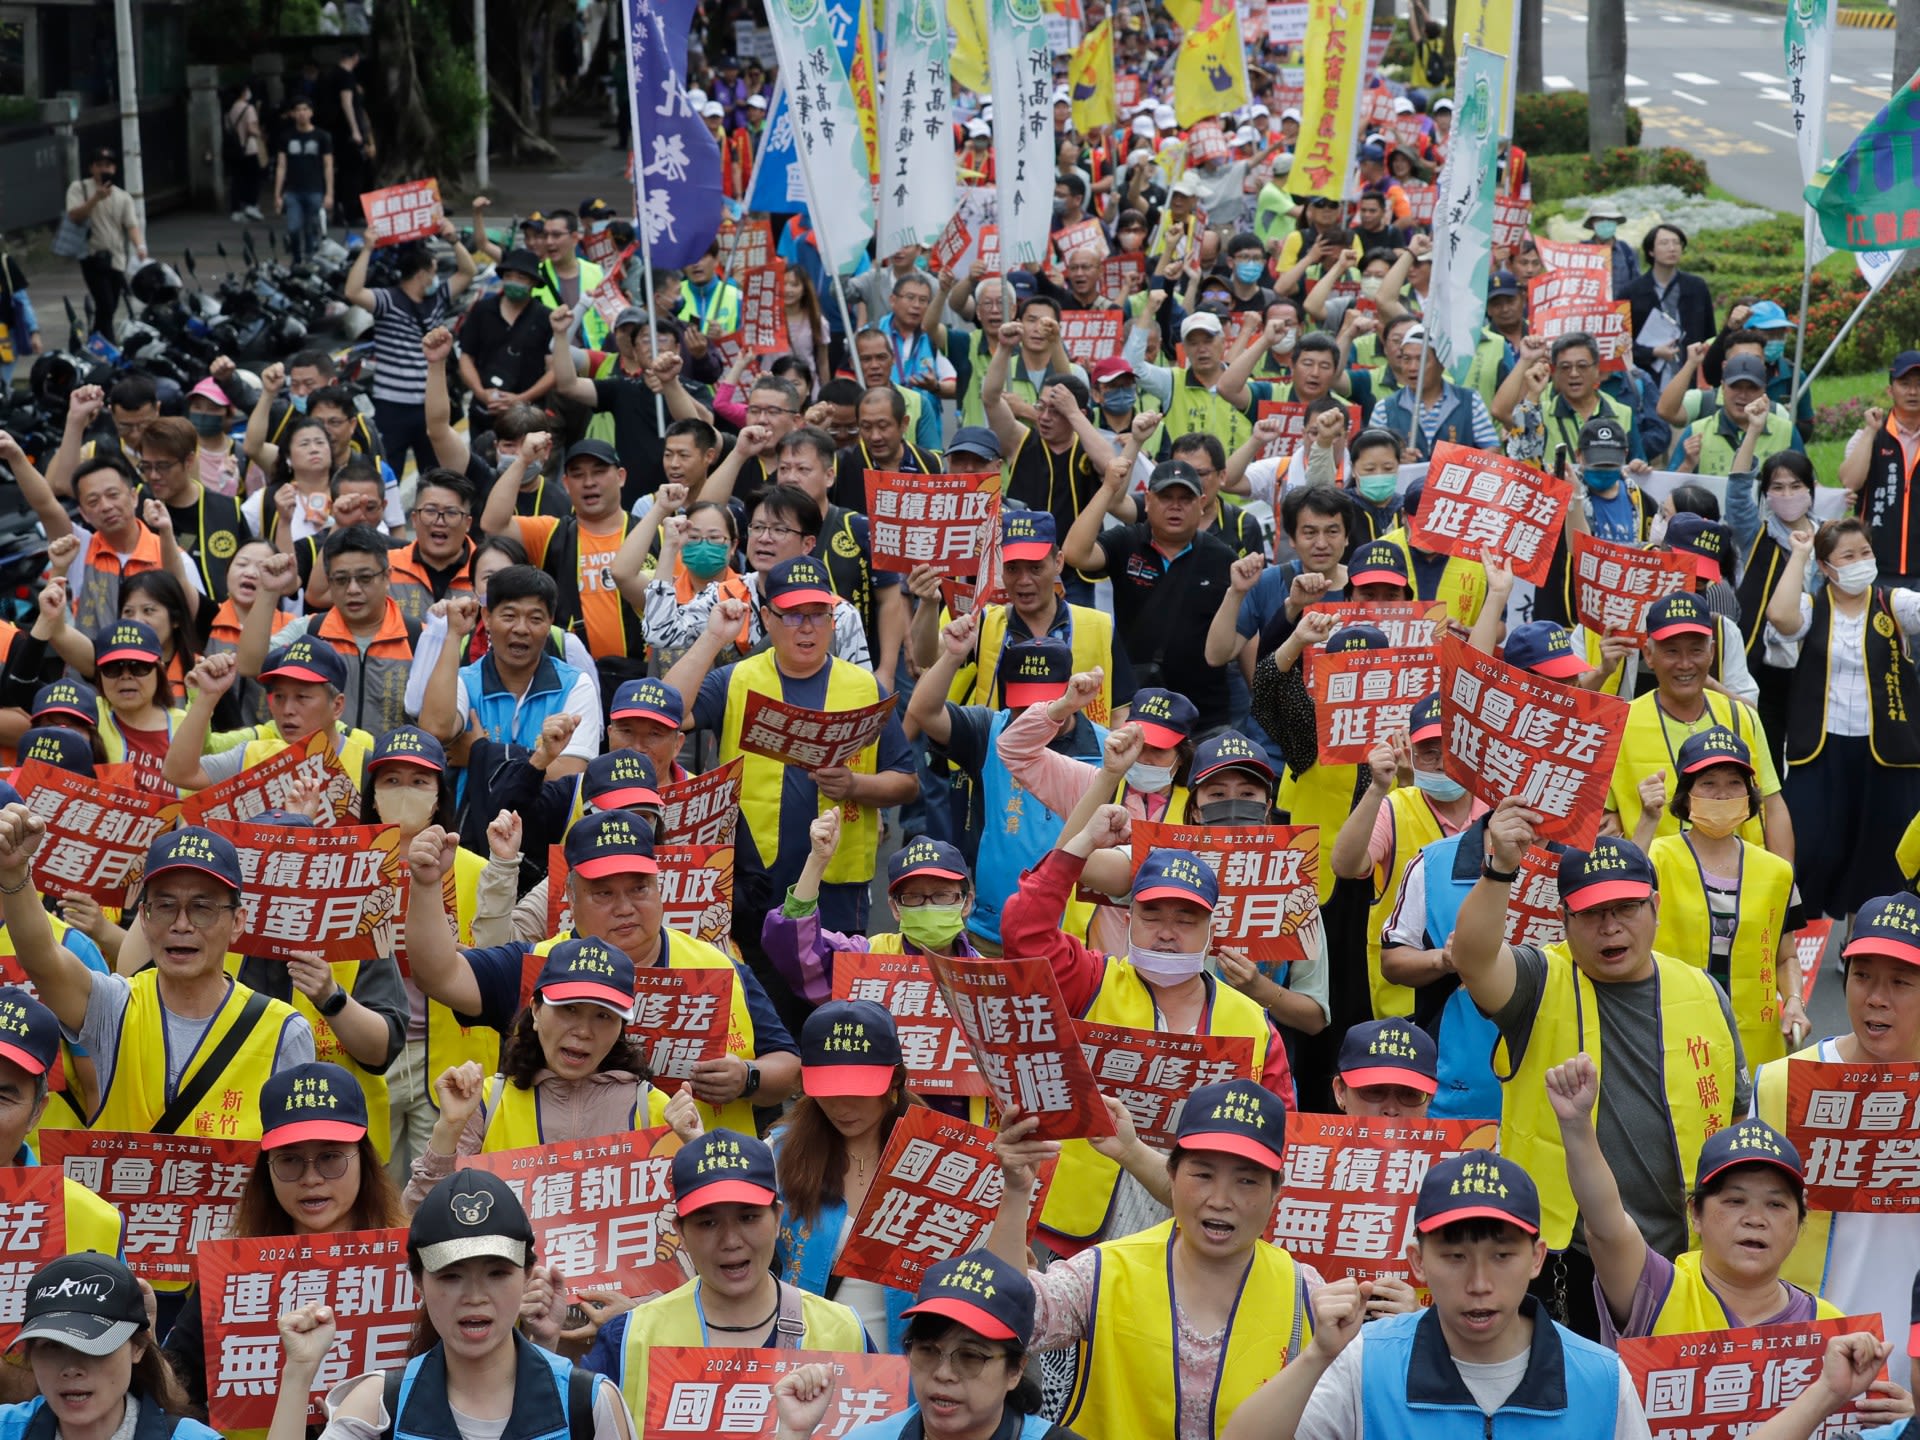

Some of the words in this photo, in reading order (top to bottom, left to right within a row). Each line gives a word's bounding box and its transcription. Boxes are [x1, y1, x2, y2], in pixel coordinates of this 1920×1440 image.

[1434, 462, 1556, 526] 國會修法
[874, 489, 992, 521] 連續執政
[1421, 497, 1542, 566] 挺勞權
[872, 521, 978, 561] 無蜜月
[1371, 547, 1392, 556] 新竹縣
[793, 565, 814, 574] 新竹縣
[1578, 551, 1688, 595] 國會修法
[1670, 599, 1692, 609] 新竹縣
[1024, 655, 1046, 666] 新竹縣
[52, 685, 76, 695] 新竹縣
[641, 683, 664, 696] 新竹縣
[1149, 696, 1171, 708] 新竹縣
[754, 706, 886, 741] 連續執政
[1449, 666, 1611, 765] 國會修法
[1328, 704, 1412, 747] 挺勞
[36, 737, 60, 749] 新竹縣
[394, 733, 418, 743] 新竹縣
[1222, 738, 1248, 747] 新竹縣
[1708, 732, 1733, 744] 新竹縣
[1216, 745, 1254, 758] 產業總工會
[615, 758, 640, 769] 新竹縣
[1449, 713, 1587, 820] 挺勞權
[26, 785, 165, 848] 連續執政
[601, 822, 630, 835] 新竹縣
[179, 835, 210, 849] 新竹縣
[596, 834, 638, 848] 產業總工會
[909, 843, 934, 854] 新竹縣
[168, 846, 216, 862] 產業總工會
[1589, 846, 1619, 862] 新竹縣
[236, 847, 389, 890] 連續執政
[1172, 858, 1199, 874] 新竹縣
[1583, 859, 1627, 875] 產業總工會
[1161, 866, 1201, 889] 產業總工會
[1884, 902, 1916, 919] 新竹縣
[1872, 914, 1920, 935] 產業總工會
[579, 946, 608, 963] 新竹縣
[568, 960, 615, 977] 產業總工會
[1759, 926, 1774, 1024] 產業總工會
[832, 1022, 864, 1036] 新竹縣
[1378, 1029, 1411, 1044] 新竹縣
[823, 1037, 871, 1053] 產業總工會
[1369, 1042, 1417, 1060] 產業總工會
[293, 1078, 329, 1092] 新竹縣
[285, 1093, 339, 1111] 產業總工會
[1225, 1091, 1260, 1112] 新竹縣
[1211, 1106, 1266, 1129] 產業總工會
[1738, 1126, 1774, 1142] 新竹縣
[704, 1142, 740, 1156] 新竹縣
[1729, 1138, 1782, 1156] 產業總工會
[696, 1156, 750, 1175] 產業總工會
[1462, 1162, 1500, 1181] 新竹縣
[63, 1156, 254, 1198] 國會修法
[1450, 1181, 1509, 1198] 產業總工會
[544, 1212, 659, 1278] 蜜月
[956, 1259, 994, 1283] 新竹縣
[938, 1273, 996, 1301] 產業總工會
[1646, 1356, 1824, 1420] 國會修
[661, 1382, 892, 1437] 國會法
